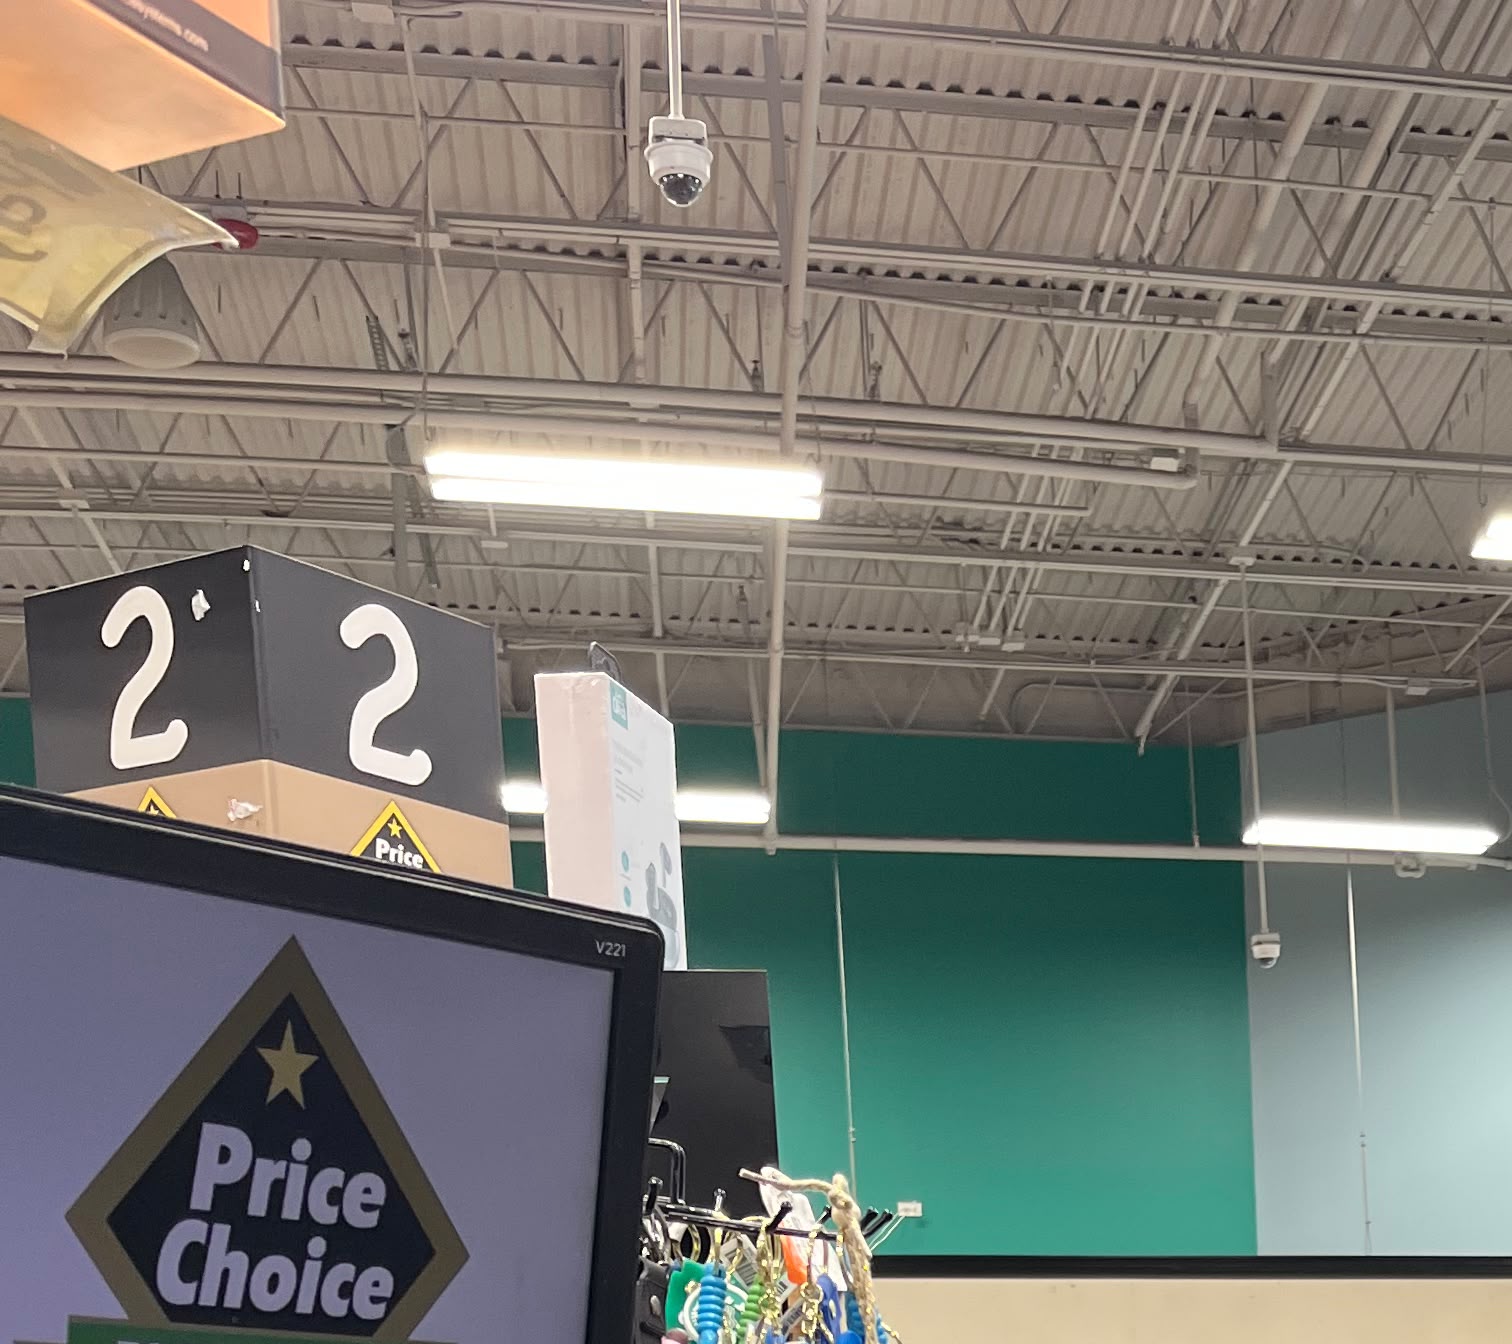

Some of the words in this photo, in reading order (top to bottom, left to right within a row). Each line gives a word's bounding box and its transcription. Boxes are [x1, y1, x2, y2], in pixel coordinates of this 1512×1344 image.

[101, 585, 188, 771] 2
[339, 603, 433, 786] 2
[375, 837, 424, 869] Price
[595, 940, 626, 957] V221
[189, 1122, 386, 1229] Price
[156, 1218, 394, 1320] Choice
